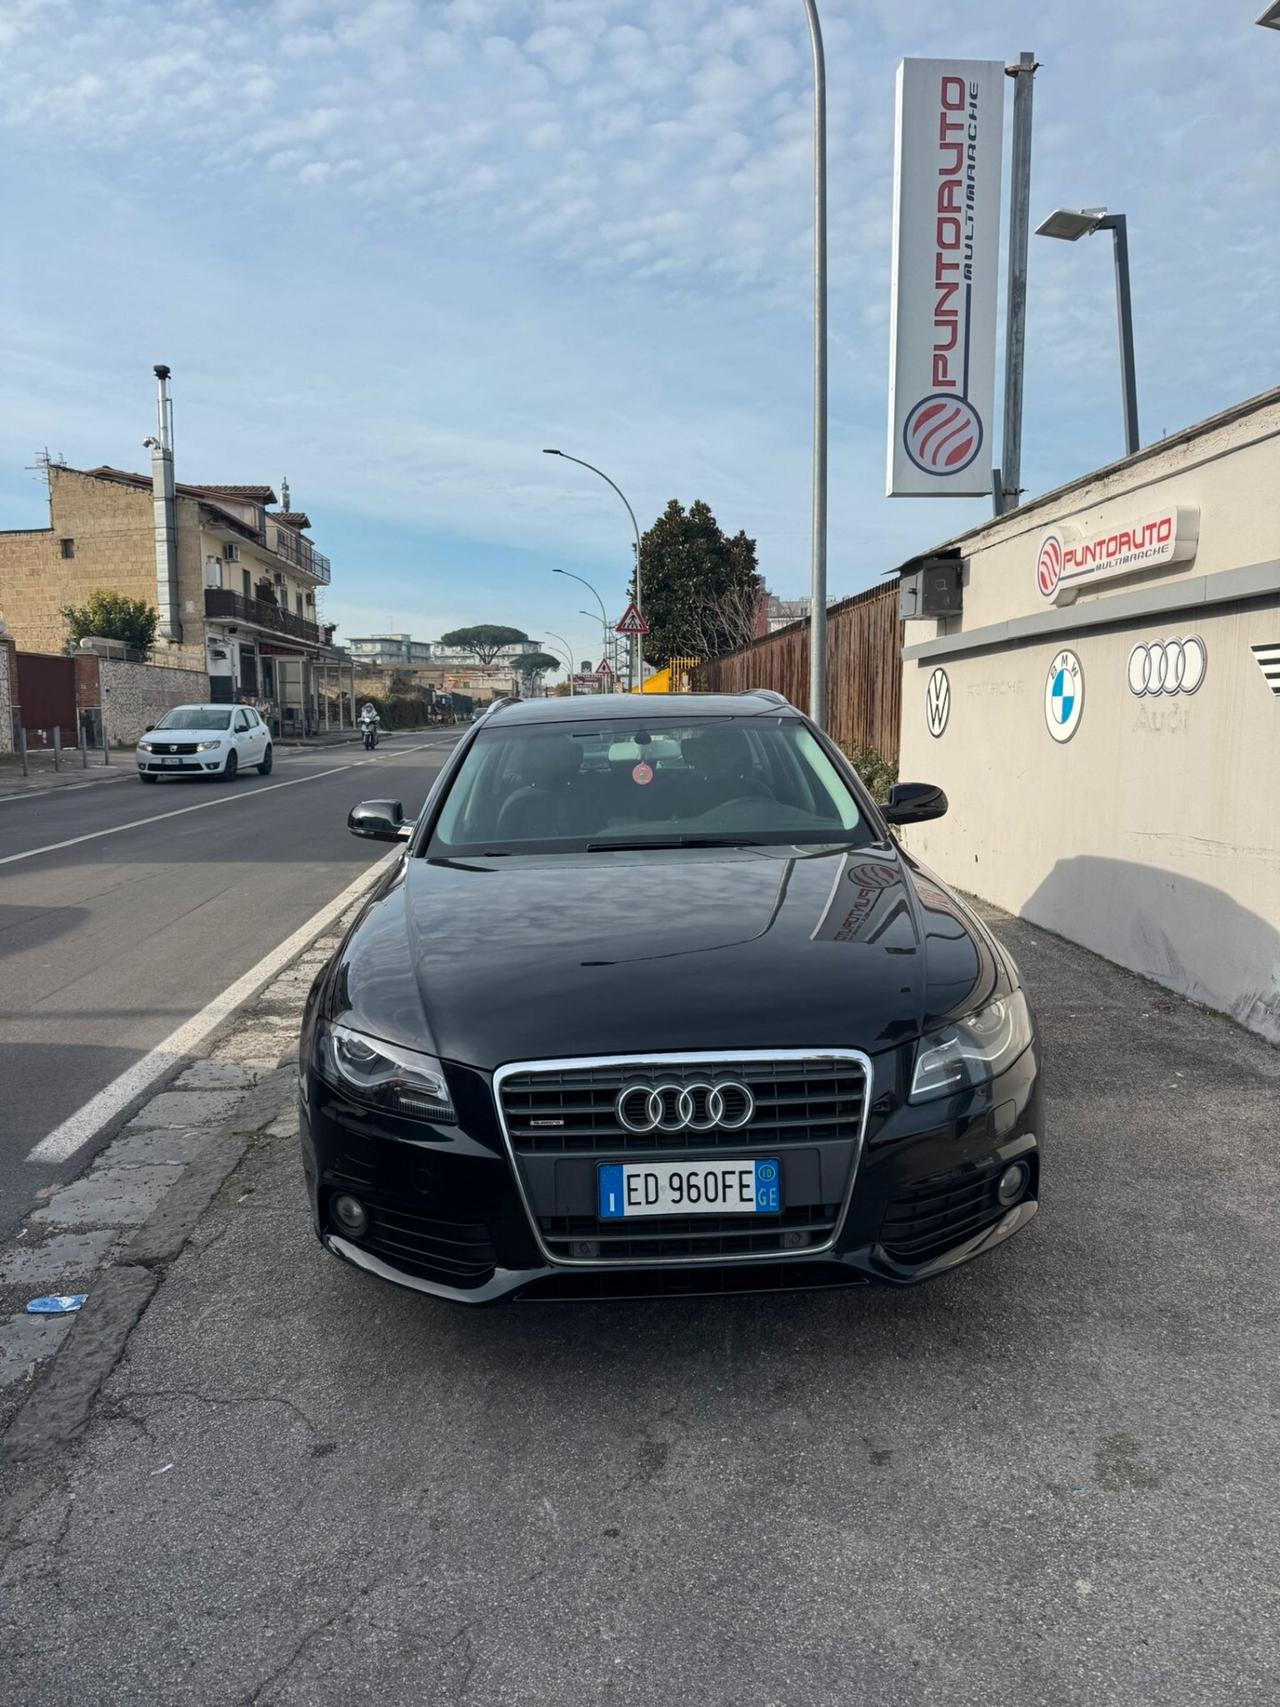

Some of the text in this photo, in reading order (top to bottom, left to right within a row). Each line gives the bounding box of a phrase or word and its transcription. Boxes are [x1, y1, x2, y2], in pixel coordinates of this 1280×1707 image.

[962, 81, 979, 280] MULTIMARCHE
[932, 76, 966, 387] PUNTOAUTO
[1063, 517, 1172, 571] PUNTOAUTO
[1095, 544, 1169, 572] MULTIMARCHE
[1050, 654, 1080, 679] BMW
[626, 1170, 754, 1206] ED 960FE
[758, 1187, 777, 1207] GE
